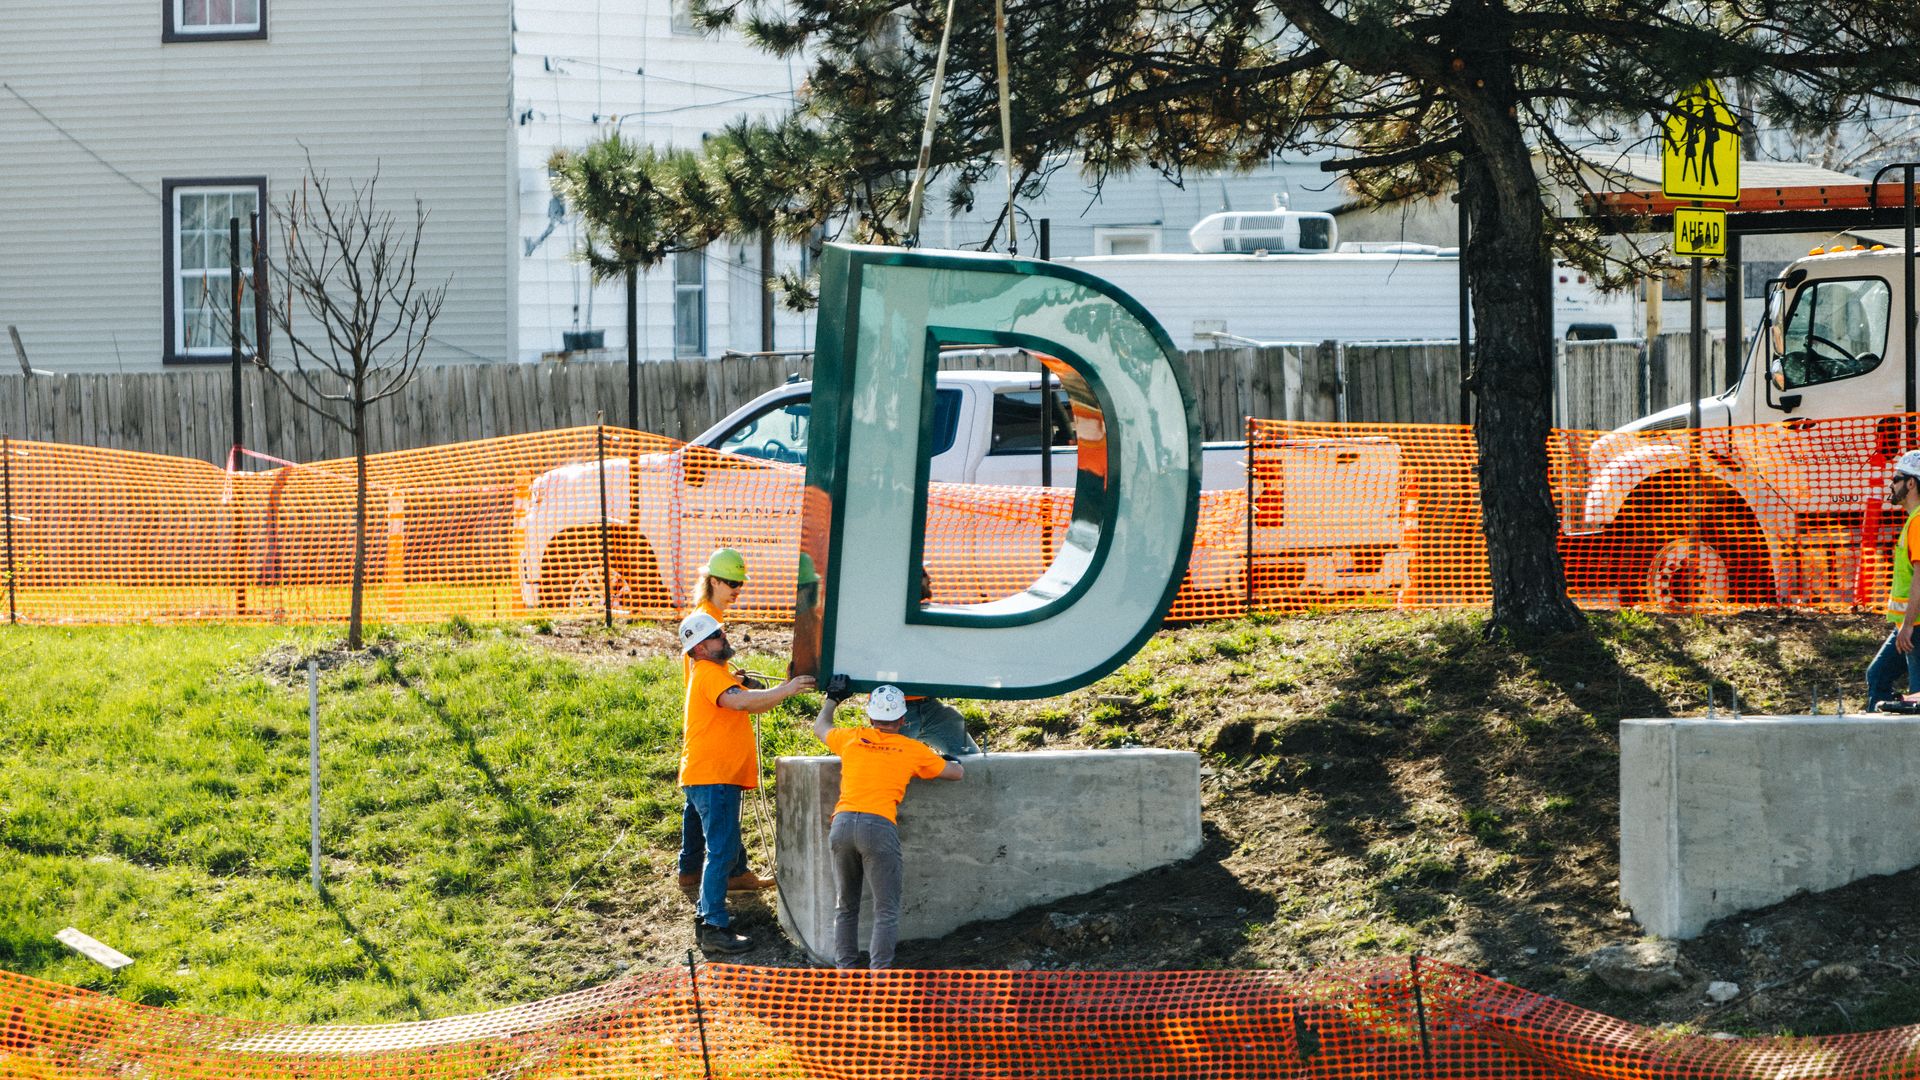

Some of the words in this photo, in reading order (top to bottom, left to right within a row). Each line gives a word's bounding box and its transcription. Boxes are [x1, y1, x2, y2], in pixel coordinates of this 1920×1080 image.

[1681, 220, 1720, 244] AHEAD
[797, 243, 1201, 700] D
[1831, 494, 1863, 503] USDO
